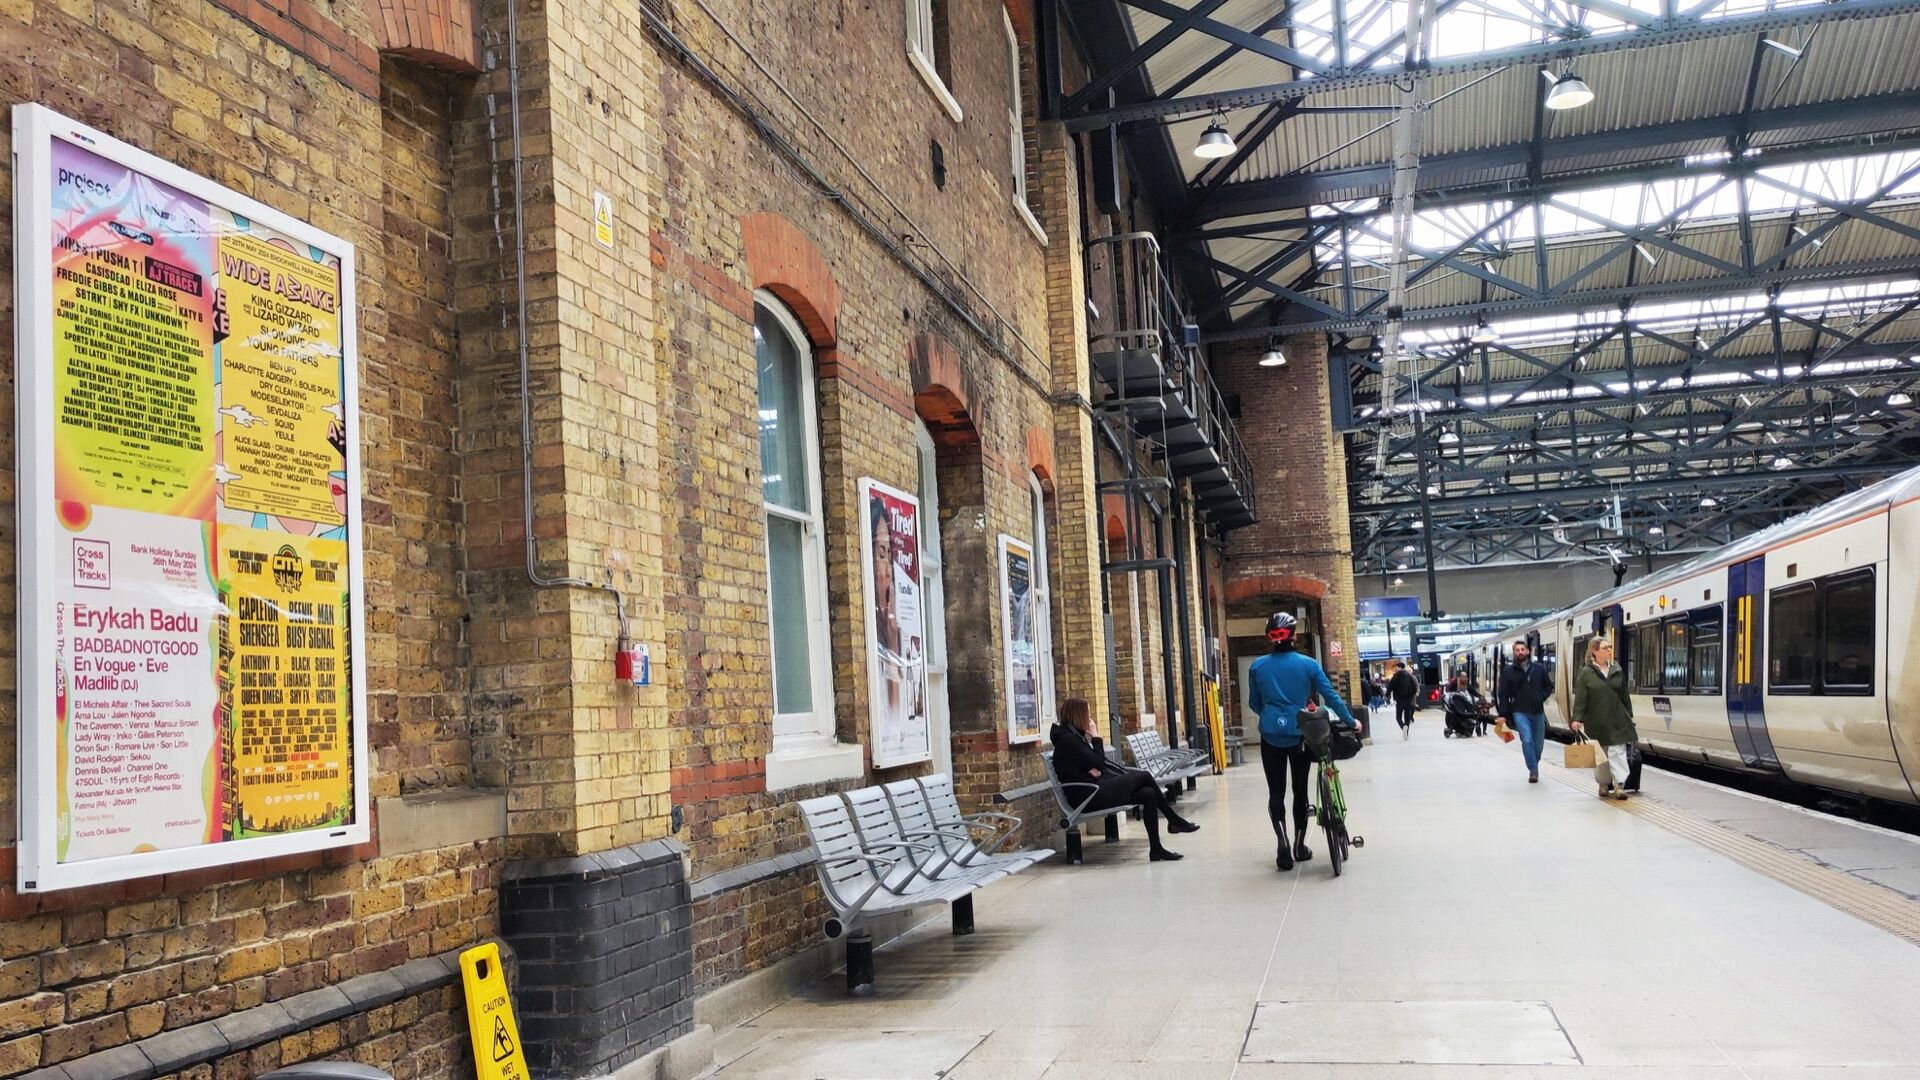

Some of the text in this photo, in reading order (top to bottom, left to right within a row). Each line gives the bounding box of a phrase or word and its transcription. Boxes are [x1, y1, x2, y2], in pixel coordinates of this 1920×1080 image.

[96, 248, 137, 273] PUSHA T
[86, 262, 176, 301] CASISDEAD ELIZA ROSE
[149, 266, 197, 294] AJ TRACEY
[222, 251, 334, 314] WIDE AWAKE
[56, 266, 91, 287] FREDDIE
[93, 278, 117, 295] GIBBS
[119, 286, 124, 298] &
[127, 289, 156, 307] MADLIB
[179, 306, 196, 320] KATY
[198, 312, 202, 322] B
[75, 286, 187, 331] SBTRKT SHY FX UNKNOWN T
[251, 293, 312, 323] KING GIZZARD
[253, 306, 319, 338] LIZARD WIZARD
[64, 331, 87, 345] SPORTS
[117, 346, 136, 358] STEAM
[260, 325, 305, 348] SLOWDIVE
[247, 336, 318, 367] YOUNG FATHERS
[224, 358, 264, 377] CHARLOTTE
[265, 370, 292, 385] ADIGERY
[269, 360, 296, 376] BEN UFO
[259, 380, 306, 400] DRY CLEANING
[250, 389, 304, 411] MODESELEKTOR
[266, 405, 301, 421] SEVDALIZA
[274, 418, 294, 430] SQUID
[274, 430, 294, 442] YEULE
[234, 435, 331, 462] ALICE GLASS CRUMB EARTHEATER
[261, 450, 287, 462] DIAMOND
[292, 457, 312, 467] HELENA
[287, 473, 308, 483] MOZART
[310, 478, 327, 487] ESTATE
[890, 507, 914, 537] Tired
[77, 546, 103, 559] Cross
[131, 544, 196, 560] Bank Holiday Sunday
[78, 558, 94, 569] The
[168, 559, 180, 568] May
[183, 560, 196, 570] 2024
[273, 554, 302, 572] CITY
[78, 569, 106, 581] Tracks
[315, 569, 335, 582] BRIXTON
[74, 603, 197, 635] Erykah Badu
[239, 597, 278, 621] CAPLETON
[317, 603, 334, 625] MAN
[240, 623, 334, 649] SHENSEEA BUSY SIGNAL
[74, 637, 198, 655] BADBADNOTGOOD
[74, 656, 168, 675] En Vogue Eve
[240, 655, 334, 671] ANTHONY B BLACK SHERIF
[75, 674, 138, 691] Madlib (DJ)
[241, 672, 335, 687] DING DONG LIBIANCA LOJAY
[75, 700, 81, 708] El
[83, 700, 109, 708] Michels
[111, 700, 127, 708] Affair
[174, 699, 190, 707] Souls
[241, 689, 260, 704] QUEEN
[262, 689, 282, 703] OMEGA
[289, 689, 301, 703] SHY
[303, 689, 309, 703] FX
[93, 711, 105, 719] Lou
[111, 711, 128, 719] Jalen
[130, 710, 155, 718] Ngonda
[75, 722, 86, 730] The
[129, 720, 149, 728] Venna
[179, 719, 199, 727] Brown
[75, 733, 91, 742] Lady
[93, 732, 110, 741] Wray
[157, 730, 183, 738] Peterson
[75, 744, 93, 752] Orion
[96, 743, 108, 751] Sun
[115, 742, 140, 750] Romare
[142, 741, 154, 749] Live
[75, 752, 150, 764] David Rodigan Sekou
[75, 762, 167, 775] Dennis Bovell Channel One
[74, 777, 102, 787] 47SOUL
[110, 776, 117, 785] 15
[131, 775, 136, 783] of
[154, 772, 180, 781] Records
[482, 996, 506, 1014] CAUTION
[500, 1061, 515, 1077] WET
